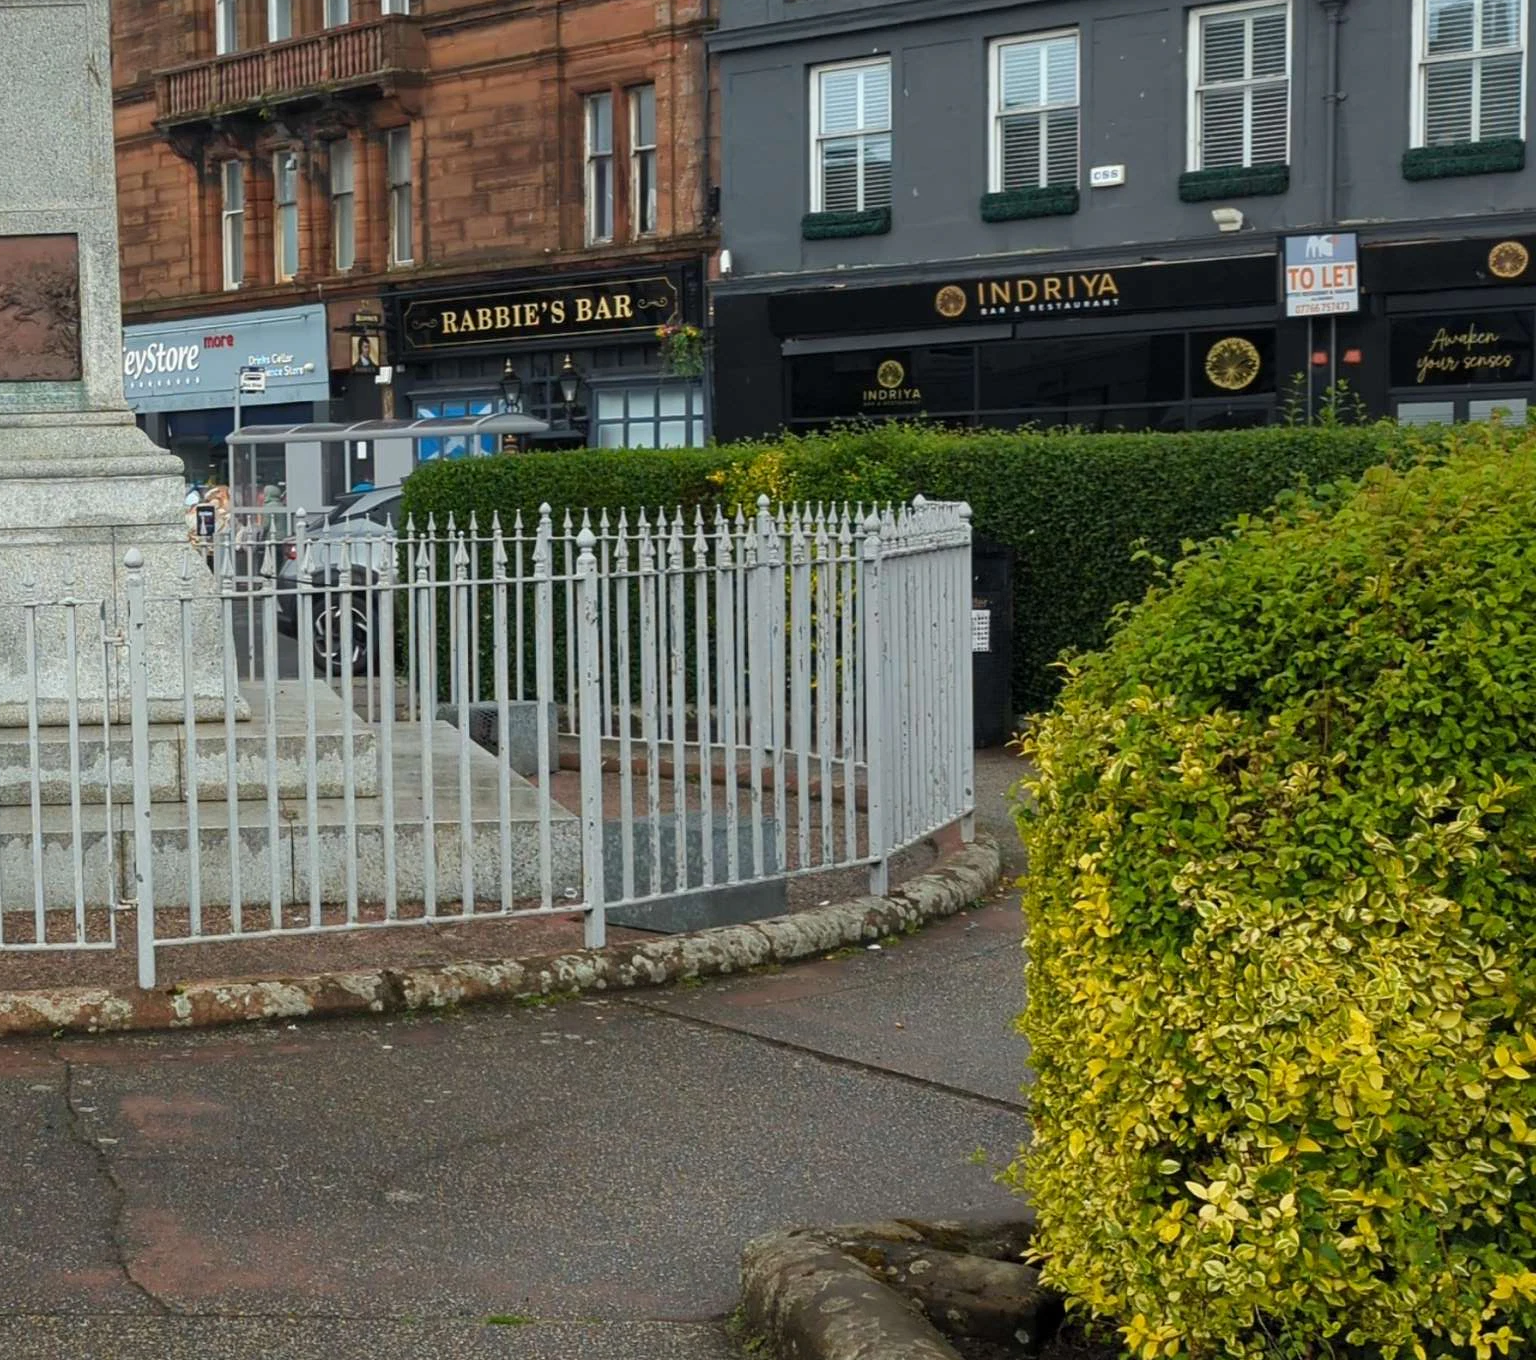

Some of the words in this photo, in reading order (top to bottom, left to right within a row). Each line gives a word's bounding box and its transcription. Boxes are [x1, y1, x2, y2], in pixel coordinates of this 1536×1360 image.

[977, 272, 1120, 305] INDRIYA
[1287, 266, 1315, 291] TO
[1321, 264, 1356, 288] LET
[440, 299, 566, 334] RABBIE'S
[575, 294, 633, 322] BAR
[980, 306, 1006, 316] BAR
[1029, 298, 1120, 312] RESTAURANT
[203, 333, 234, 349] more
[1428, 322, 1500, 351] Awaken
[122, 342, 200, 380] eyStore
[1416, 354, 1460, 383] your
[1463, 354, 1514, 369] senses
[863, 387, 921, 401] INDRIYA
